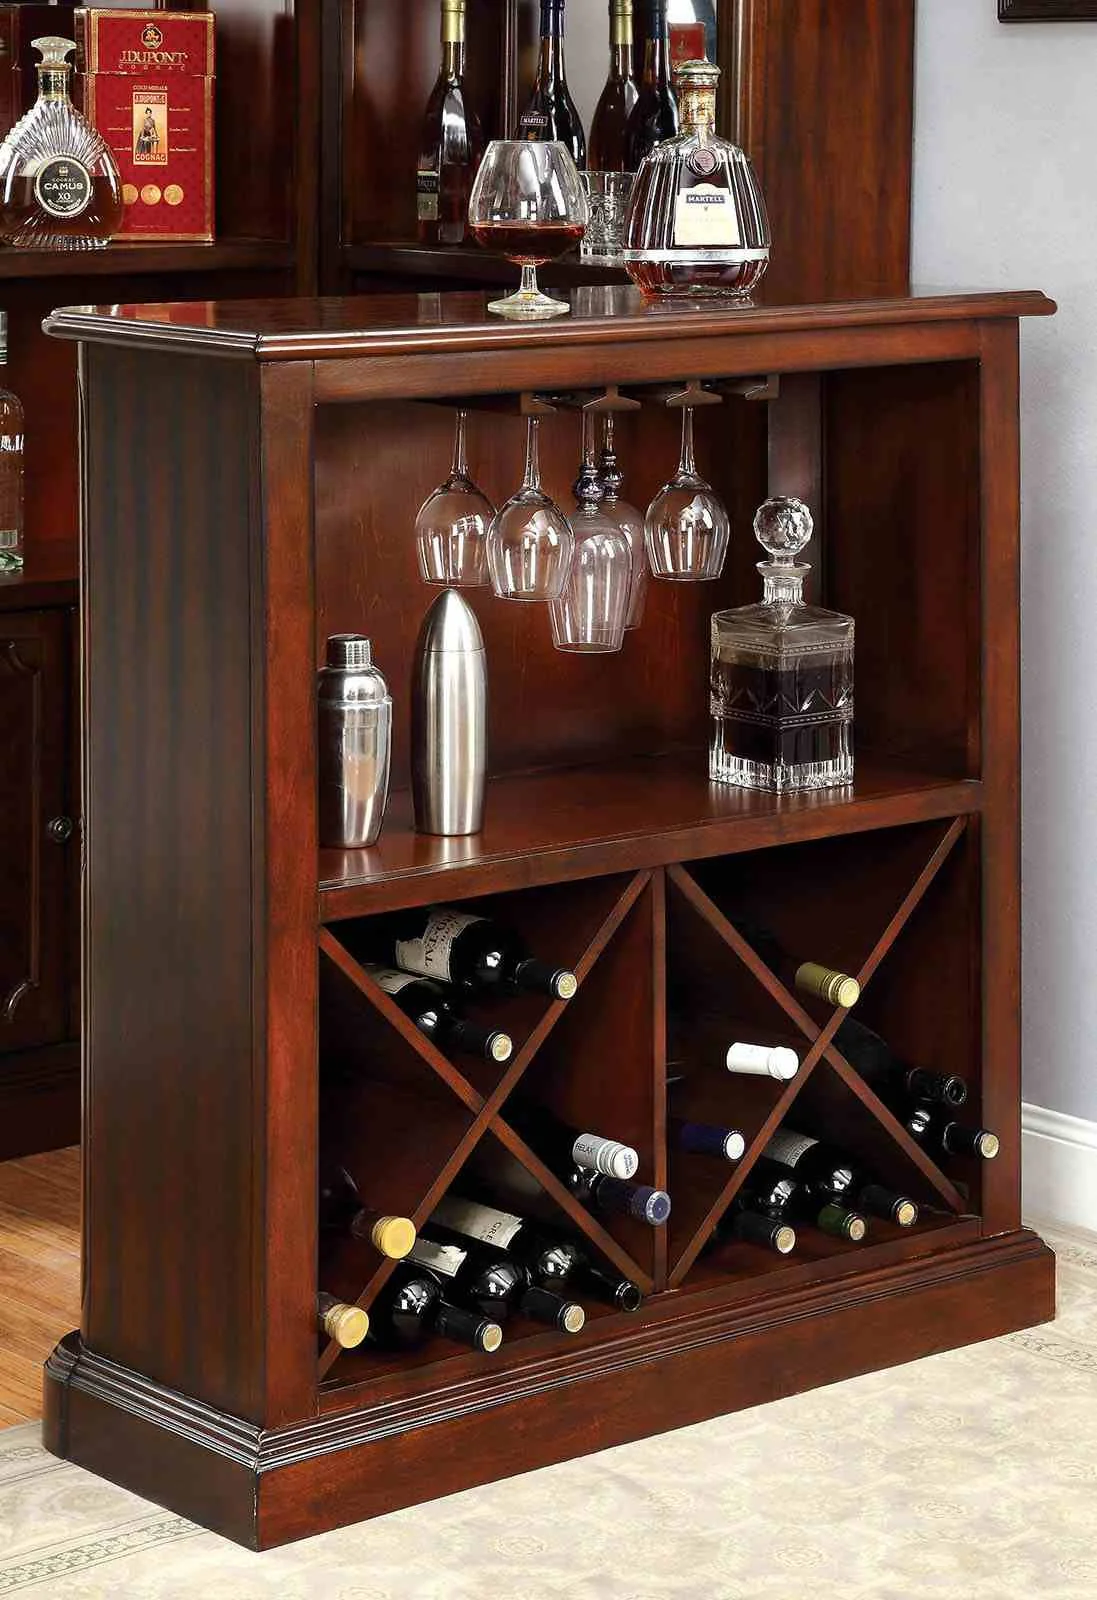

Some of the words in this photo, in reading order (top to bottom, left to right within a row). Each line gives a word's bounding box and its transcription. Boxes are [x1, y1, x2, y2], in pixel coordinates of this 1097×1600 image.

[135, 153, 166, 161] COGNAC
[44, 182, 84, 190] CAMUS
[58, 192, 71, 201] XO
